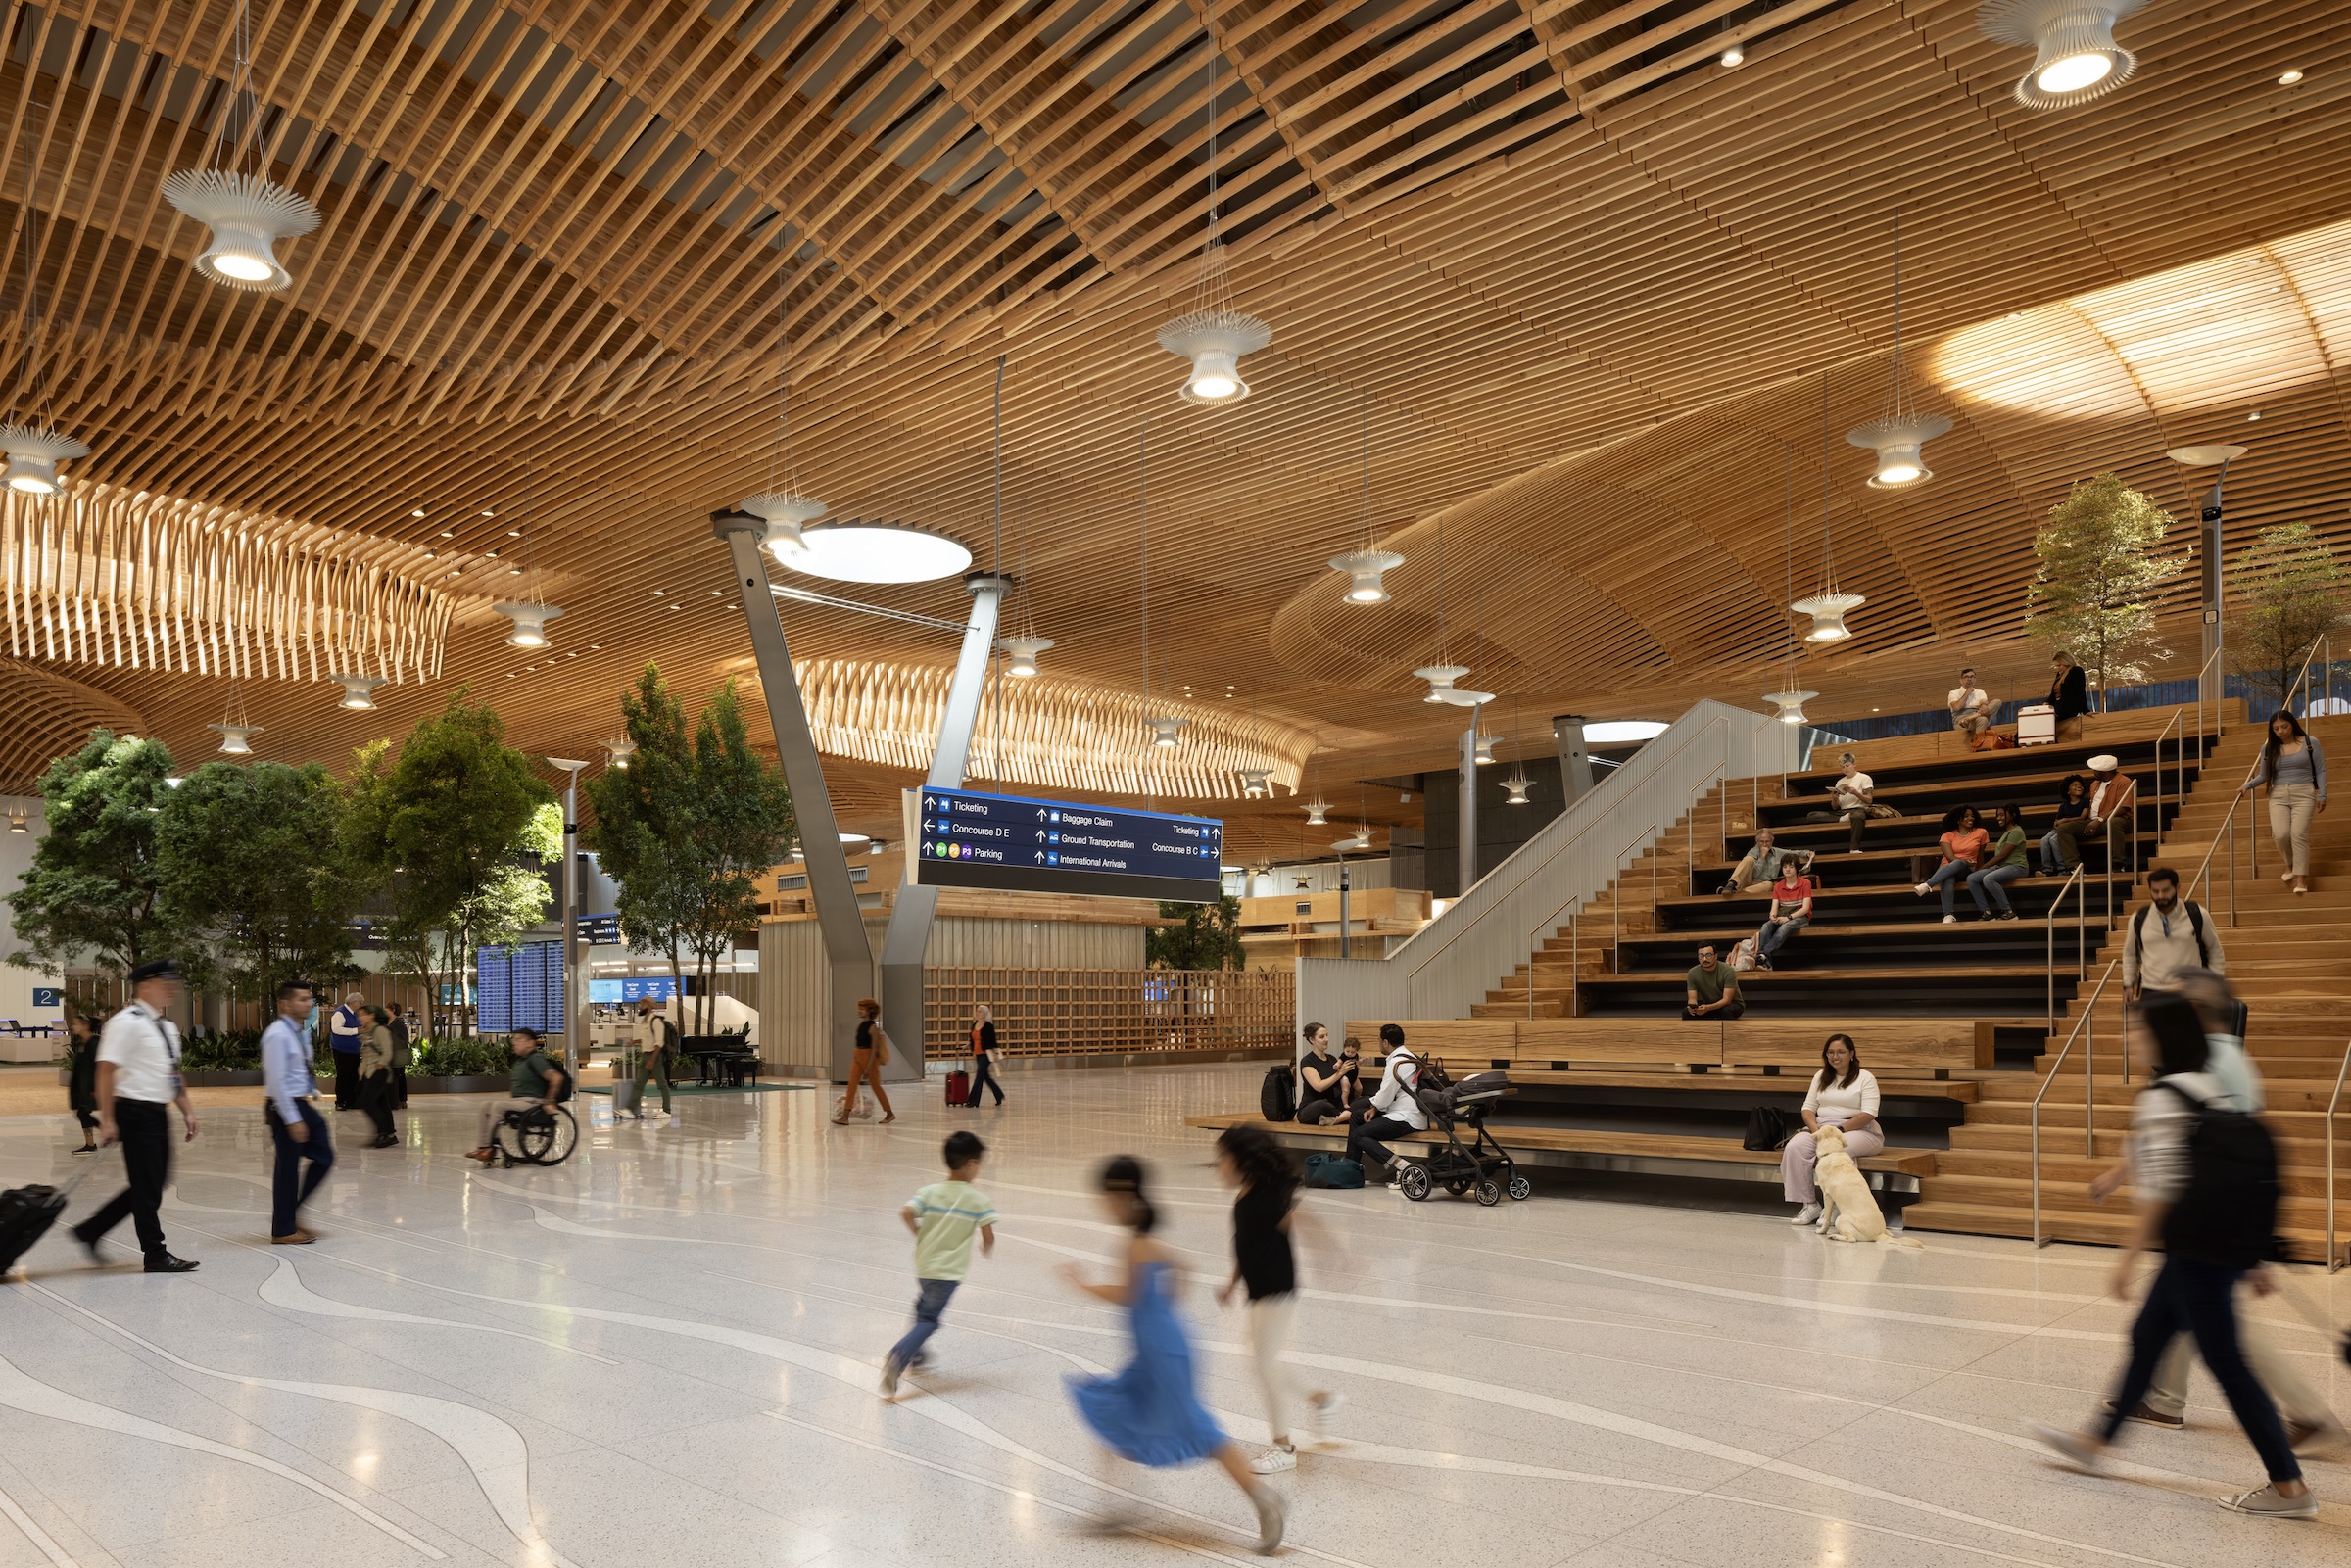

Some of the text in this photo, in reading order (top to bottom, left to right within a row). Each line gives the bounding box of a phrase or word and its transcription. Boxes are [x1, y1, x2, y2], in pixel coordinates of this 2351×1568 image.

[954, 801, 988, 815] Ticketing
[1062, 814, 1114, 827] Baggage Claim
[952, 824, 993, 836] Concourse
[1004, 829, 1010, 837] E
[1173, 825, 1199, 837] Ticketing
[1061, 834, 1135, 849] Ground Transportation
[937, 845, 946, 854] P1
[975, 848, 1003, 861] Parking
[1152, 843, 1185, 855] Concourse
[1060, 855, 1127, 869] International Arrivals
[41, 990, 52, 1004] 2
